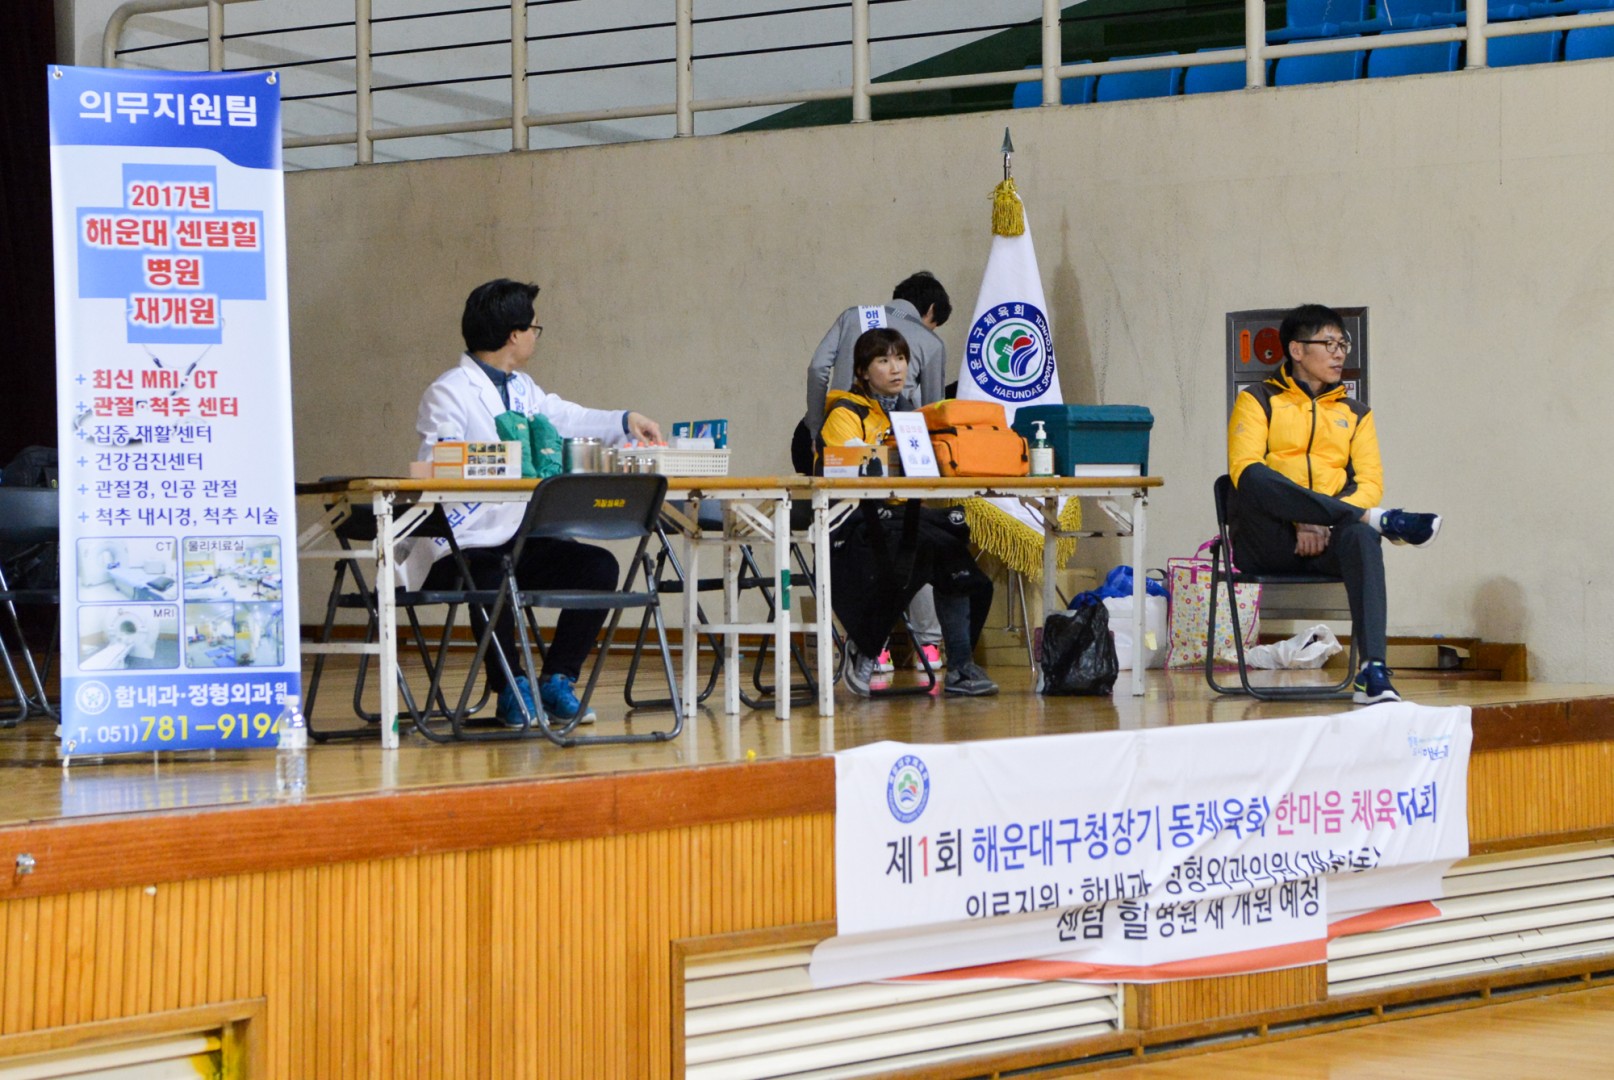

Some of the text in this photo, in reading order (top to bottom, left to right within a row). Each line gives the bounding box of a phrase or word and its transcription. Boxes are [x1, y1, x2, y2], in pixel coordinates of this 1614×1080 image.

[79, 90, 258, 127] 의무지원팀
[131, 184, 211, 209] 2017년
[86, 218, 257, 248] 해운대 센텀힐
[147, 258, 200, 286] 병원
[134, 297, 215, 325] 재개원
[969, 304, 1025, 385] 해운대구체육회
[92, 369, 134, 389] 최신
[993, 384, 1043, 399] HAEUNDAE
[1041, 355, 1054, 387] SPORTS
[198, 397, 239, 417] 센터
[94, 425, 213, 444] 집중 재활 센터
[95, 453, 203, 471] 건강검진센터
[95, 480, 238, 499] 관절경, 인공 관절
[96, 507, 279, 527] 척추 내시경, 척추 시술
[156, 541, 172, 552] CT
[188, 540, 244, 552] 물리치료실
[153, 609, 175, 618] MRI
[886, 828, 963, 884] 제1회
[972, 803, 1162, 873] 해운대구청장기
[1168, 796, 1272, 848] 동체육회
[1275, 790, 1344, 836] 한마음
[1280, 877, 1319, 918] 예정
